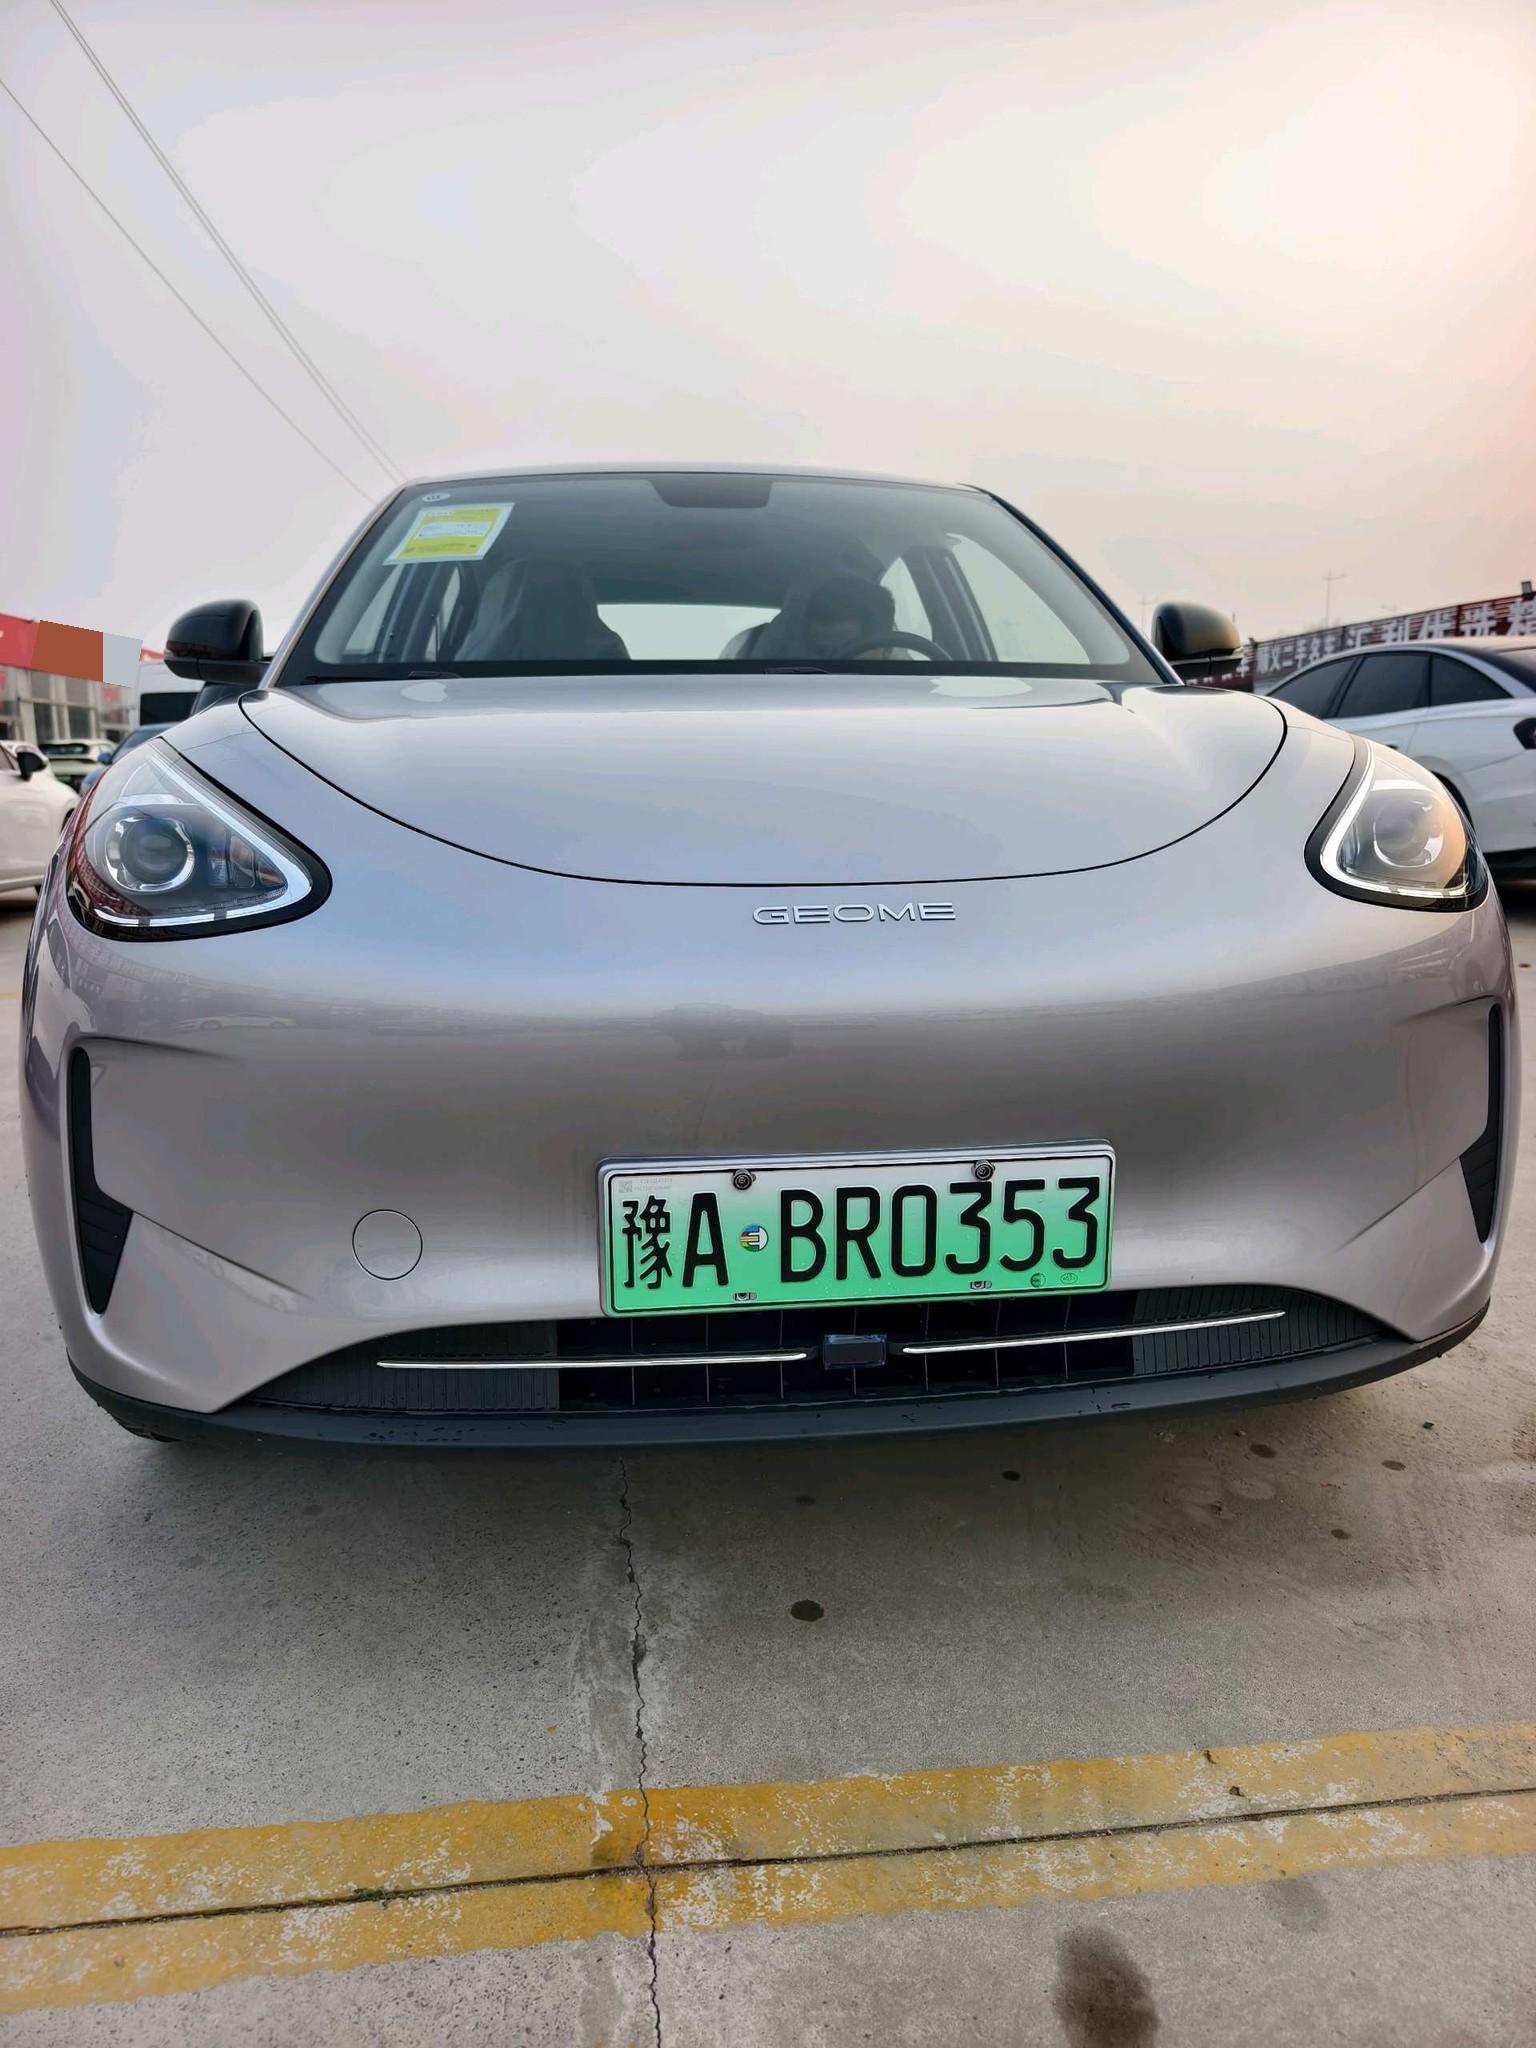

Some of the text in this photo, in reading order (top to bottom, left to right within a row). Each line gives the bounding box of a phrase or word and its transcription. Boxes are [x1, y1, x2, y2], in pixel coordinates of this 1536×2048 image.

[753, 902, 956, 925] GEOME
[621, 1175, 1101, 1290] 豫A BR0353
